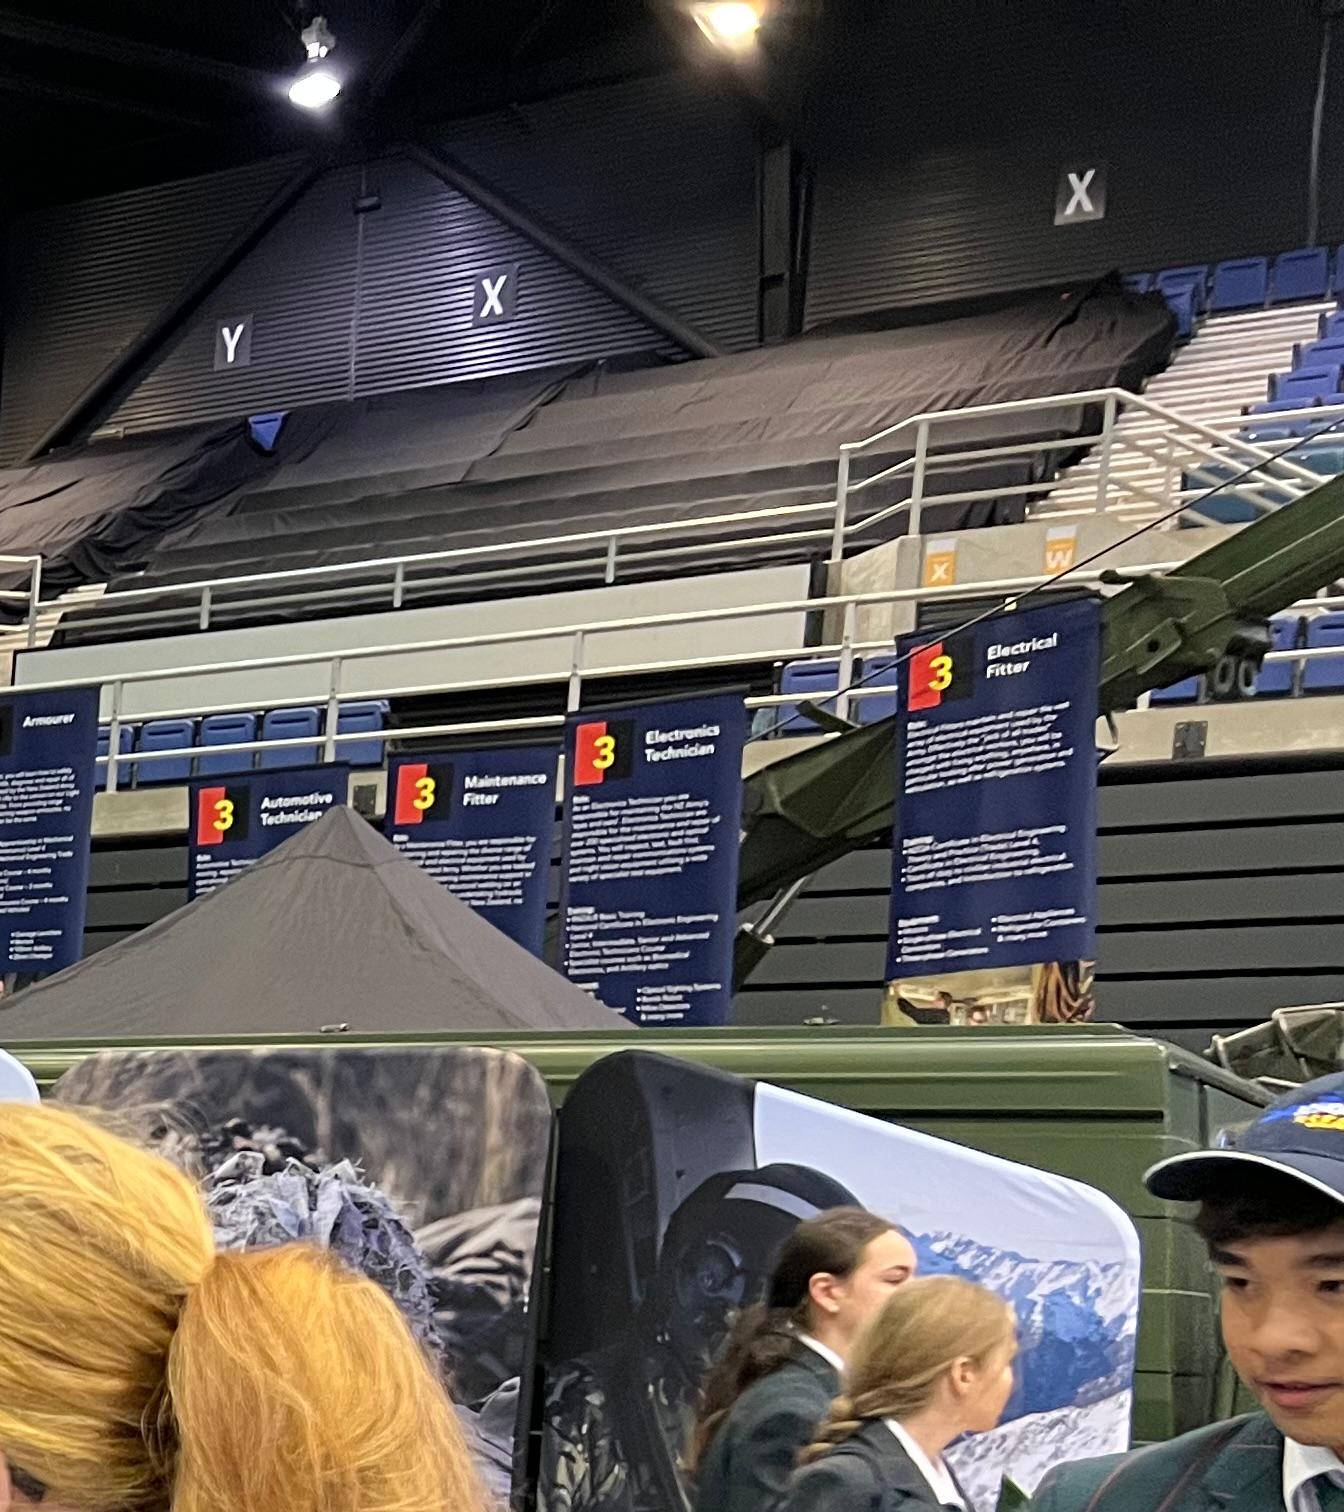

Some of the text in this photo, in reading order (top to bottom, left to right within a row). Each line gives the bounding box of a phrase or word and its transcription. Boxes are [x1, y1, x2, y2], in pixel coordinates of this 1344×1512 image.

[1064, 168, 1096, 215] X
[480, 275, 507, 318] X
[221, 323, 244, 363] Y
[1045, 548, 1074, 569] W
[930, 562, 950, 582] X
[987, 632, 1058, 660] Electrical
[928, 655, 953, 691] 3
[986, 661, 1030, 679] Fitter
[22, 713, 75, 728] Armourer
[645, 724, 720, 744] Electronics
[592, 735, 615, 769] 3
[645, 743, 715, 762] Technician
[464, 774, 547, 789] Maintenance
[261, 792, 333, 810] Automotive
[413, 777, 436, 810] 3
[463, 792, 499, 806] Fitter
[213, 799, 234, 831] 3
